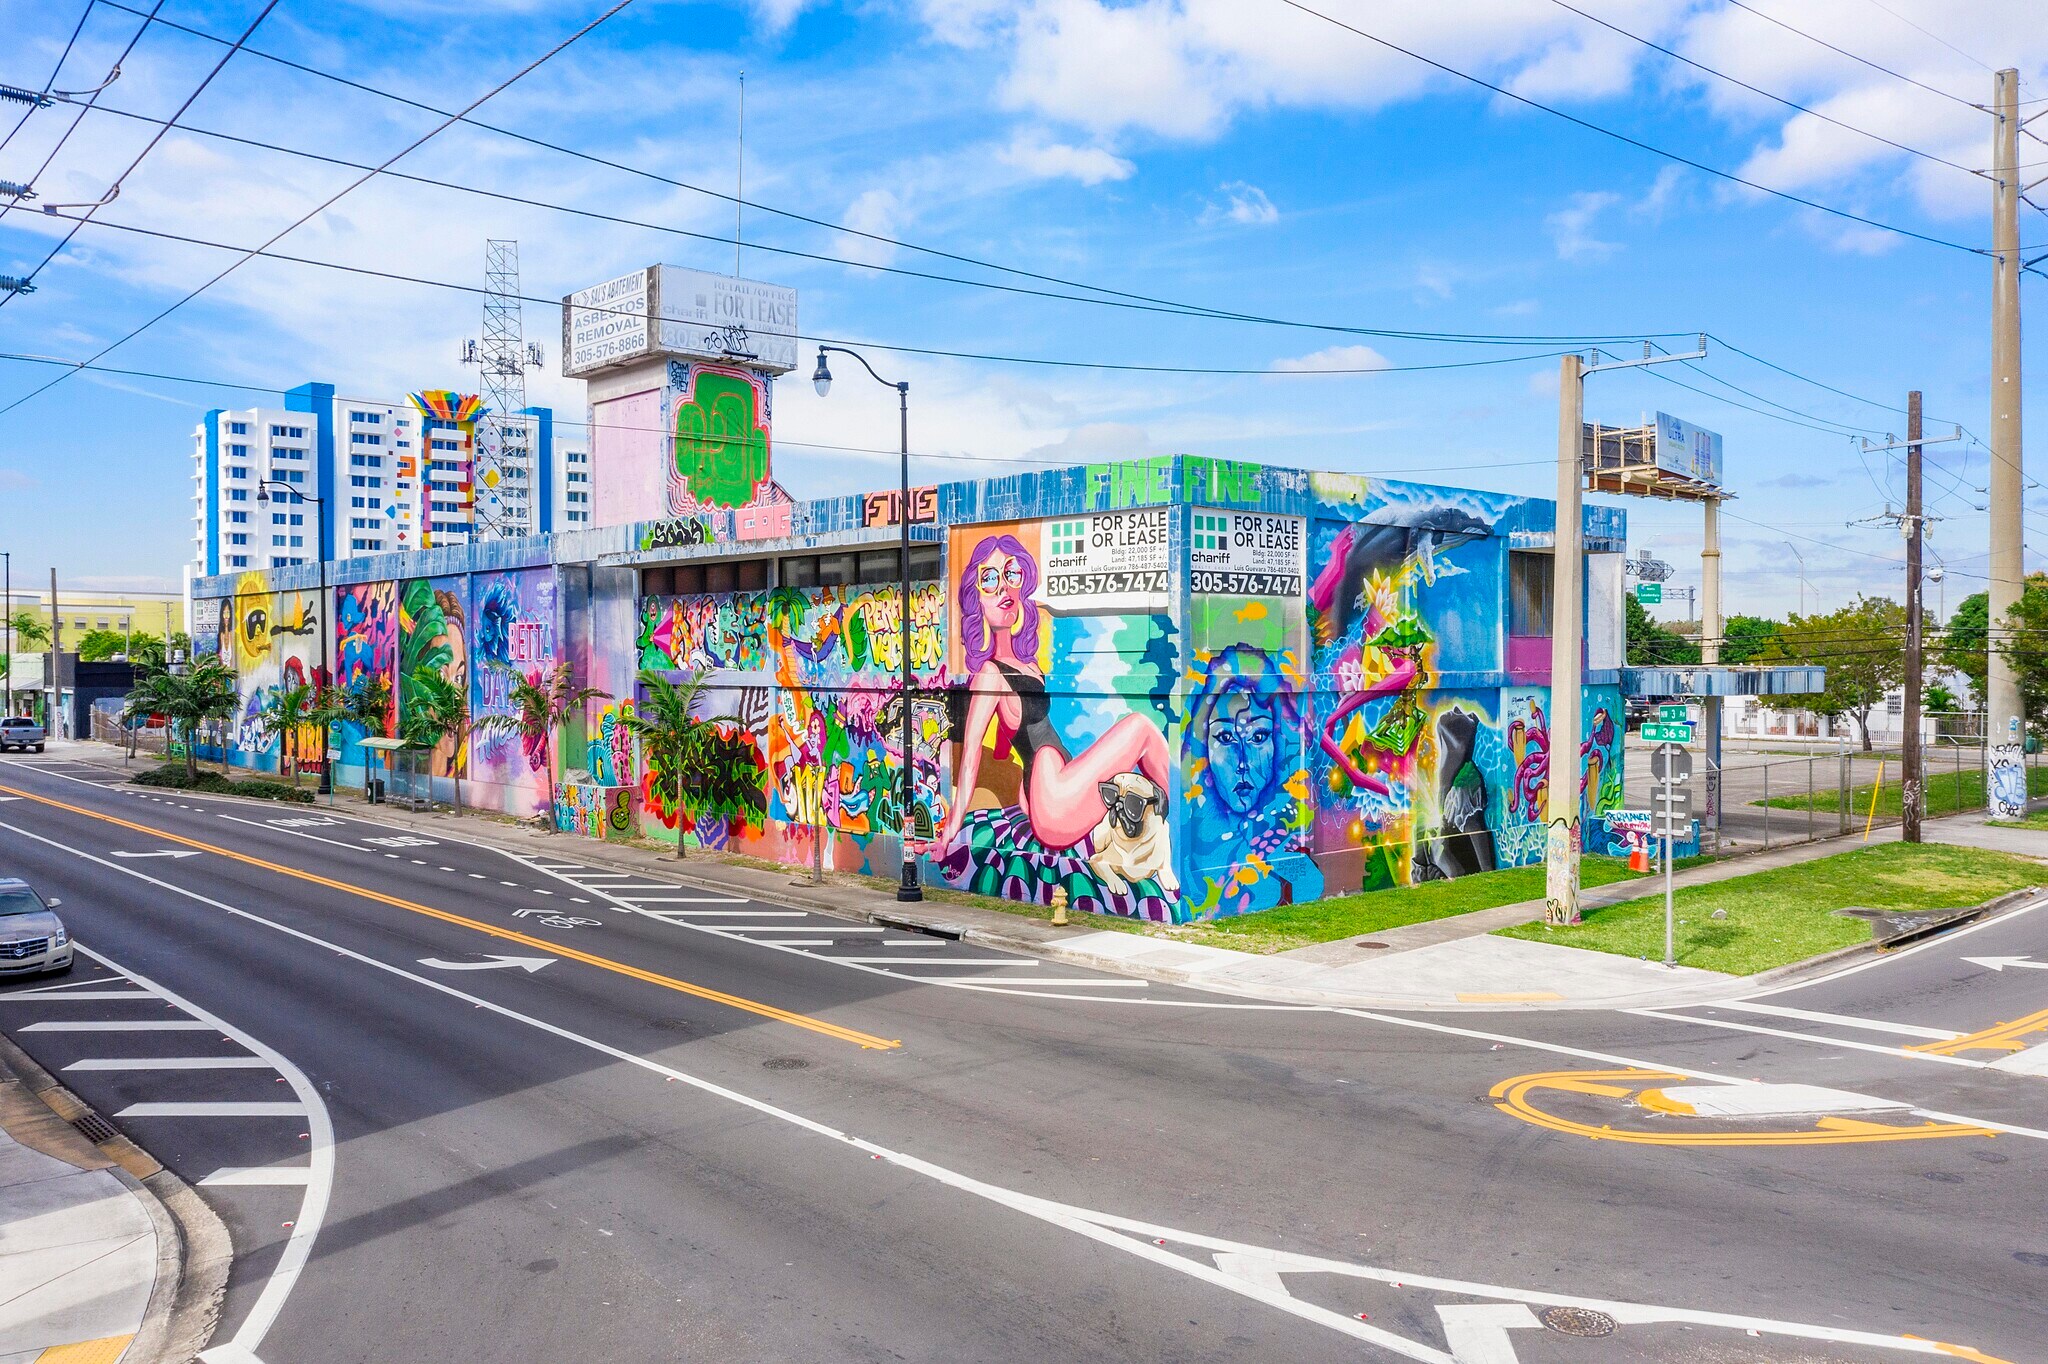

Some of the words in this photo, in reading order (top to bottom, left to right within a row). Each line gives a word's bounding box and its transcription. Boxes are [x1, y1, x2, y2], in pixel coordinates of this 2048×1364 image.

[607, 272, 644, 300] ABATEMENT
[575, 297, 645, 330] ASBESTOS
[714, 292, 745, 319] FOR
[577, 316, 641, 344] REMOVAL
[574, 333, 645, 365] 305-576-8866
[1086, 455, 1171, 510] FINE
[1183, 455, 1262, 502] FINE
[863, 484, 937, 527] FINE
[1093, 515, 1123, 532] FOR
[1128, 511, 1167, 530] SALE
[1234, 515, 1262, 532] FOR
[1266, 518, 1299, 535] SALE
[1092, 532, 1113, 548] OR
[1119, 528, 1167, 546] LEASE
[1234, 532, 1254, 548] OR
[1259, 533, 1299, 551] LEASE
[1111, 548, 1127, 556] Bldg:
[1128, 546, 1148, 554] 22,000
[1149, 545, 1157, 553] SF
[1128, 555, 1148, 563] 47,185
[1191, 551, 1230, 564] chariff
[1048, 555, 1087, 568] chariff
[1103, 564, 1127, 572] Guevara
[1128, 561, 1168, 571] 786-487-5402
[1246, 565, 1267, 573] Guevara
[1267, 566, 1300, 574] 786-487-5402
[1047, 571, 1169, 596] 305-576-7474
[1190, 571, 1301, 595] 305-576-7474
[507, 622, 554, 662] BETTA
[1660, 710, 1668, 718] NW
[1671, 708, 1676, 720] 3
[1644, 728, 1657, 737] NW
[1661, 727, 1677, 739] 36
[1678, 729, 1687, 739] St
[266, 817, 346, 827] ONLY
[360, 836, 440, 848] BUS
